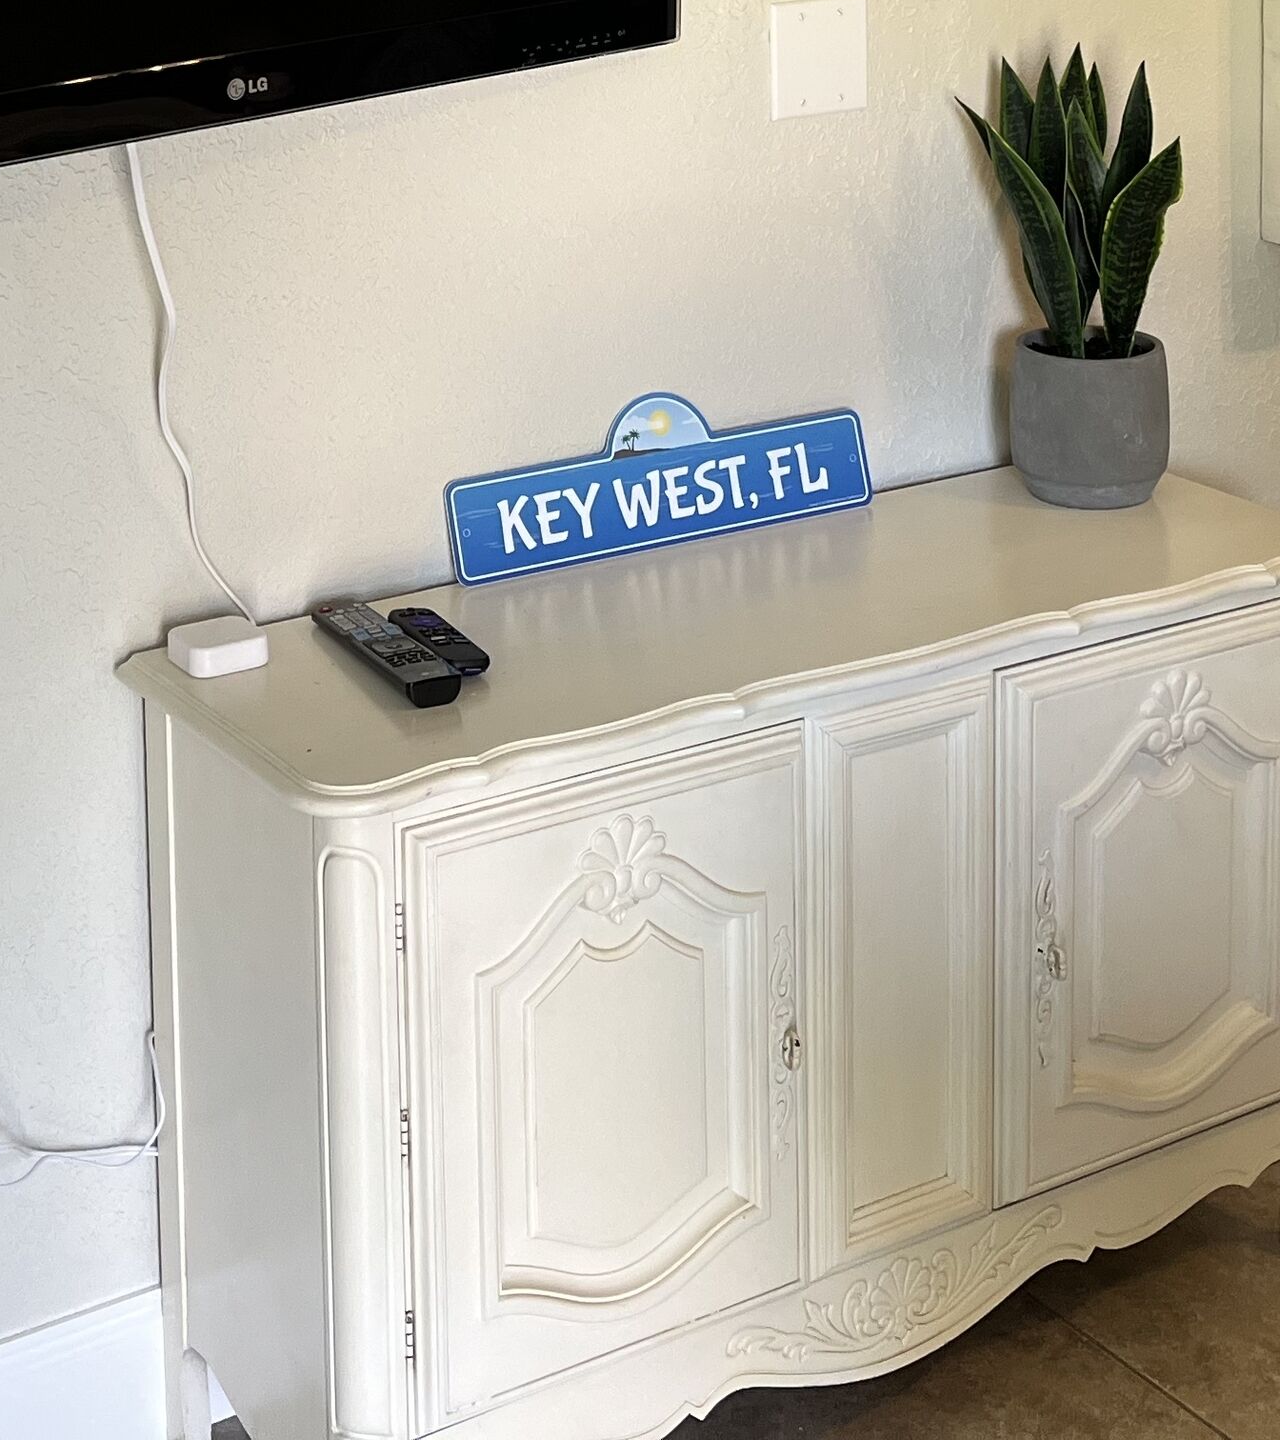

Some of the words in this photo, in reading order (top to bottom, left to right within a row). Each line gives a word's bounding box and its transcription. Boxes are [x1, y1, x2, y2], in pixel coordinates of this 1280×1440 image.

[496, 482, 600, 555] KEY
[612, 454, 760, 530] WEST,
[766, 442, 830, 501] FL
